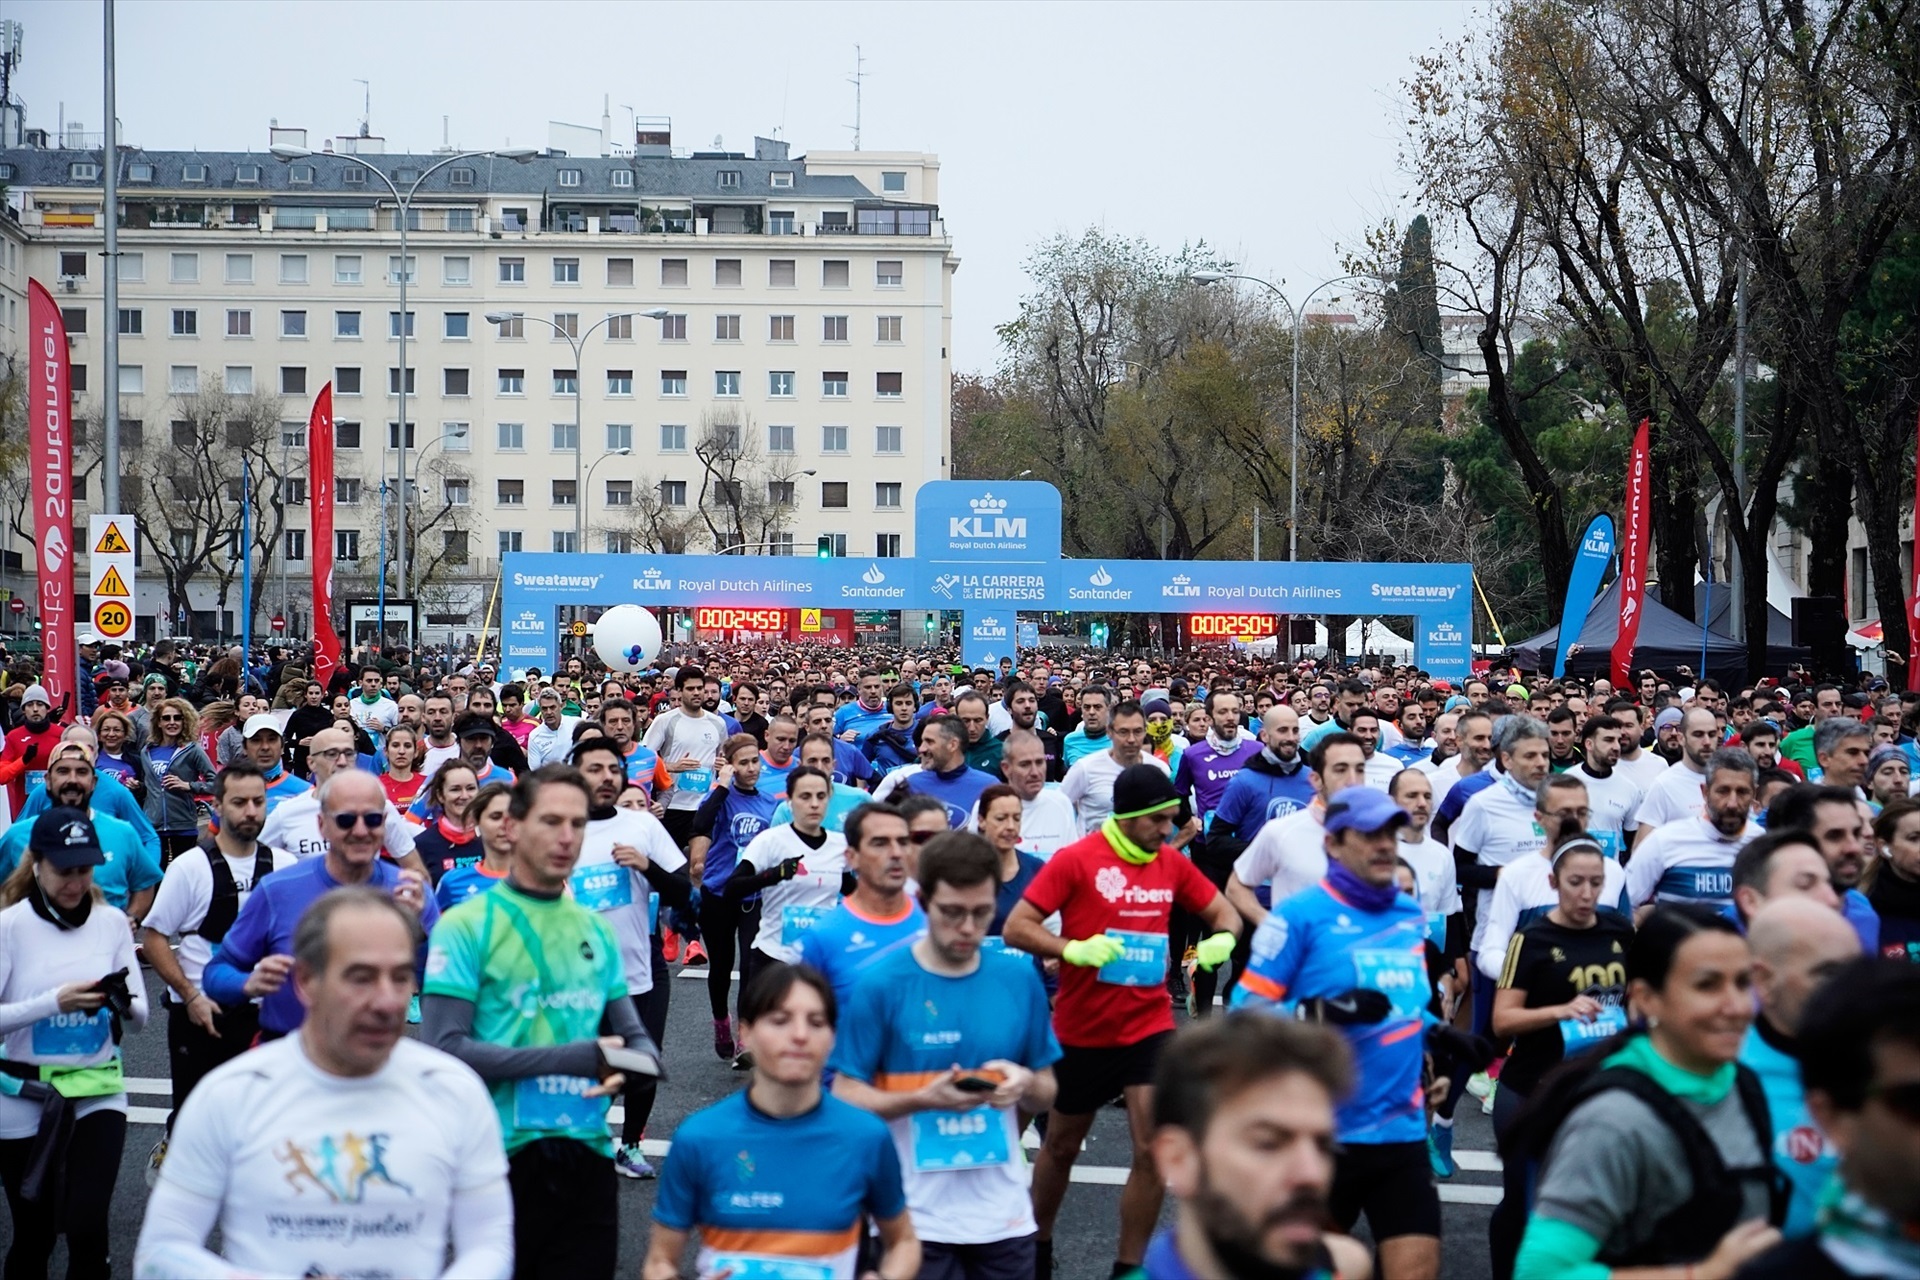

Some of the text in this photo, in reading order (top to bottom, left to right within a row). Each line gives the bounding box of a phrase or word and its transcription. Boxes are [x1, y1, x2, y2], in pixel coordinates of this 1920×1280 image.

[949, 517, 1027, 538] KLM
[949, 542, 971, 550] Royal
[997, 542, 1027, 550] Airlines
[1584, 539, 1610, 554] KLM
[513, 572, 599, 589] Sweataway
[633, 579, 813, 593] KLM Royal Dutch Airlines
[963, 575, 1045, 587] LA CARRERA
[842, 585, 905, 598] Santander
[974, 588, 1046, 600] EMPRESAS
[1069, 587, 1133, 600] Santander
[1162, 586, 1341, 600] KLM Royal Dutch Airlines
[1371, 584, 1456, 599] Sweataway
[101, 611, 125, 626] 20
[511, 620, 545, 630] KLM
[574, 625, 585, 633] 20
[973, 626, 1006, 636] KLM
[1428, 632, 1462, 641] KLM
[509, 644, 547, 655] Expansión
[739, 817, 761, 834] life
[299, 838, 331, 854] Ent
[1567, 961, 1627, 993] 100
